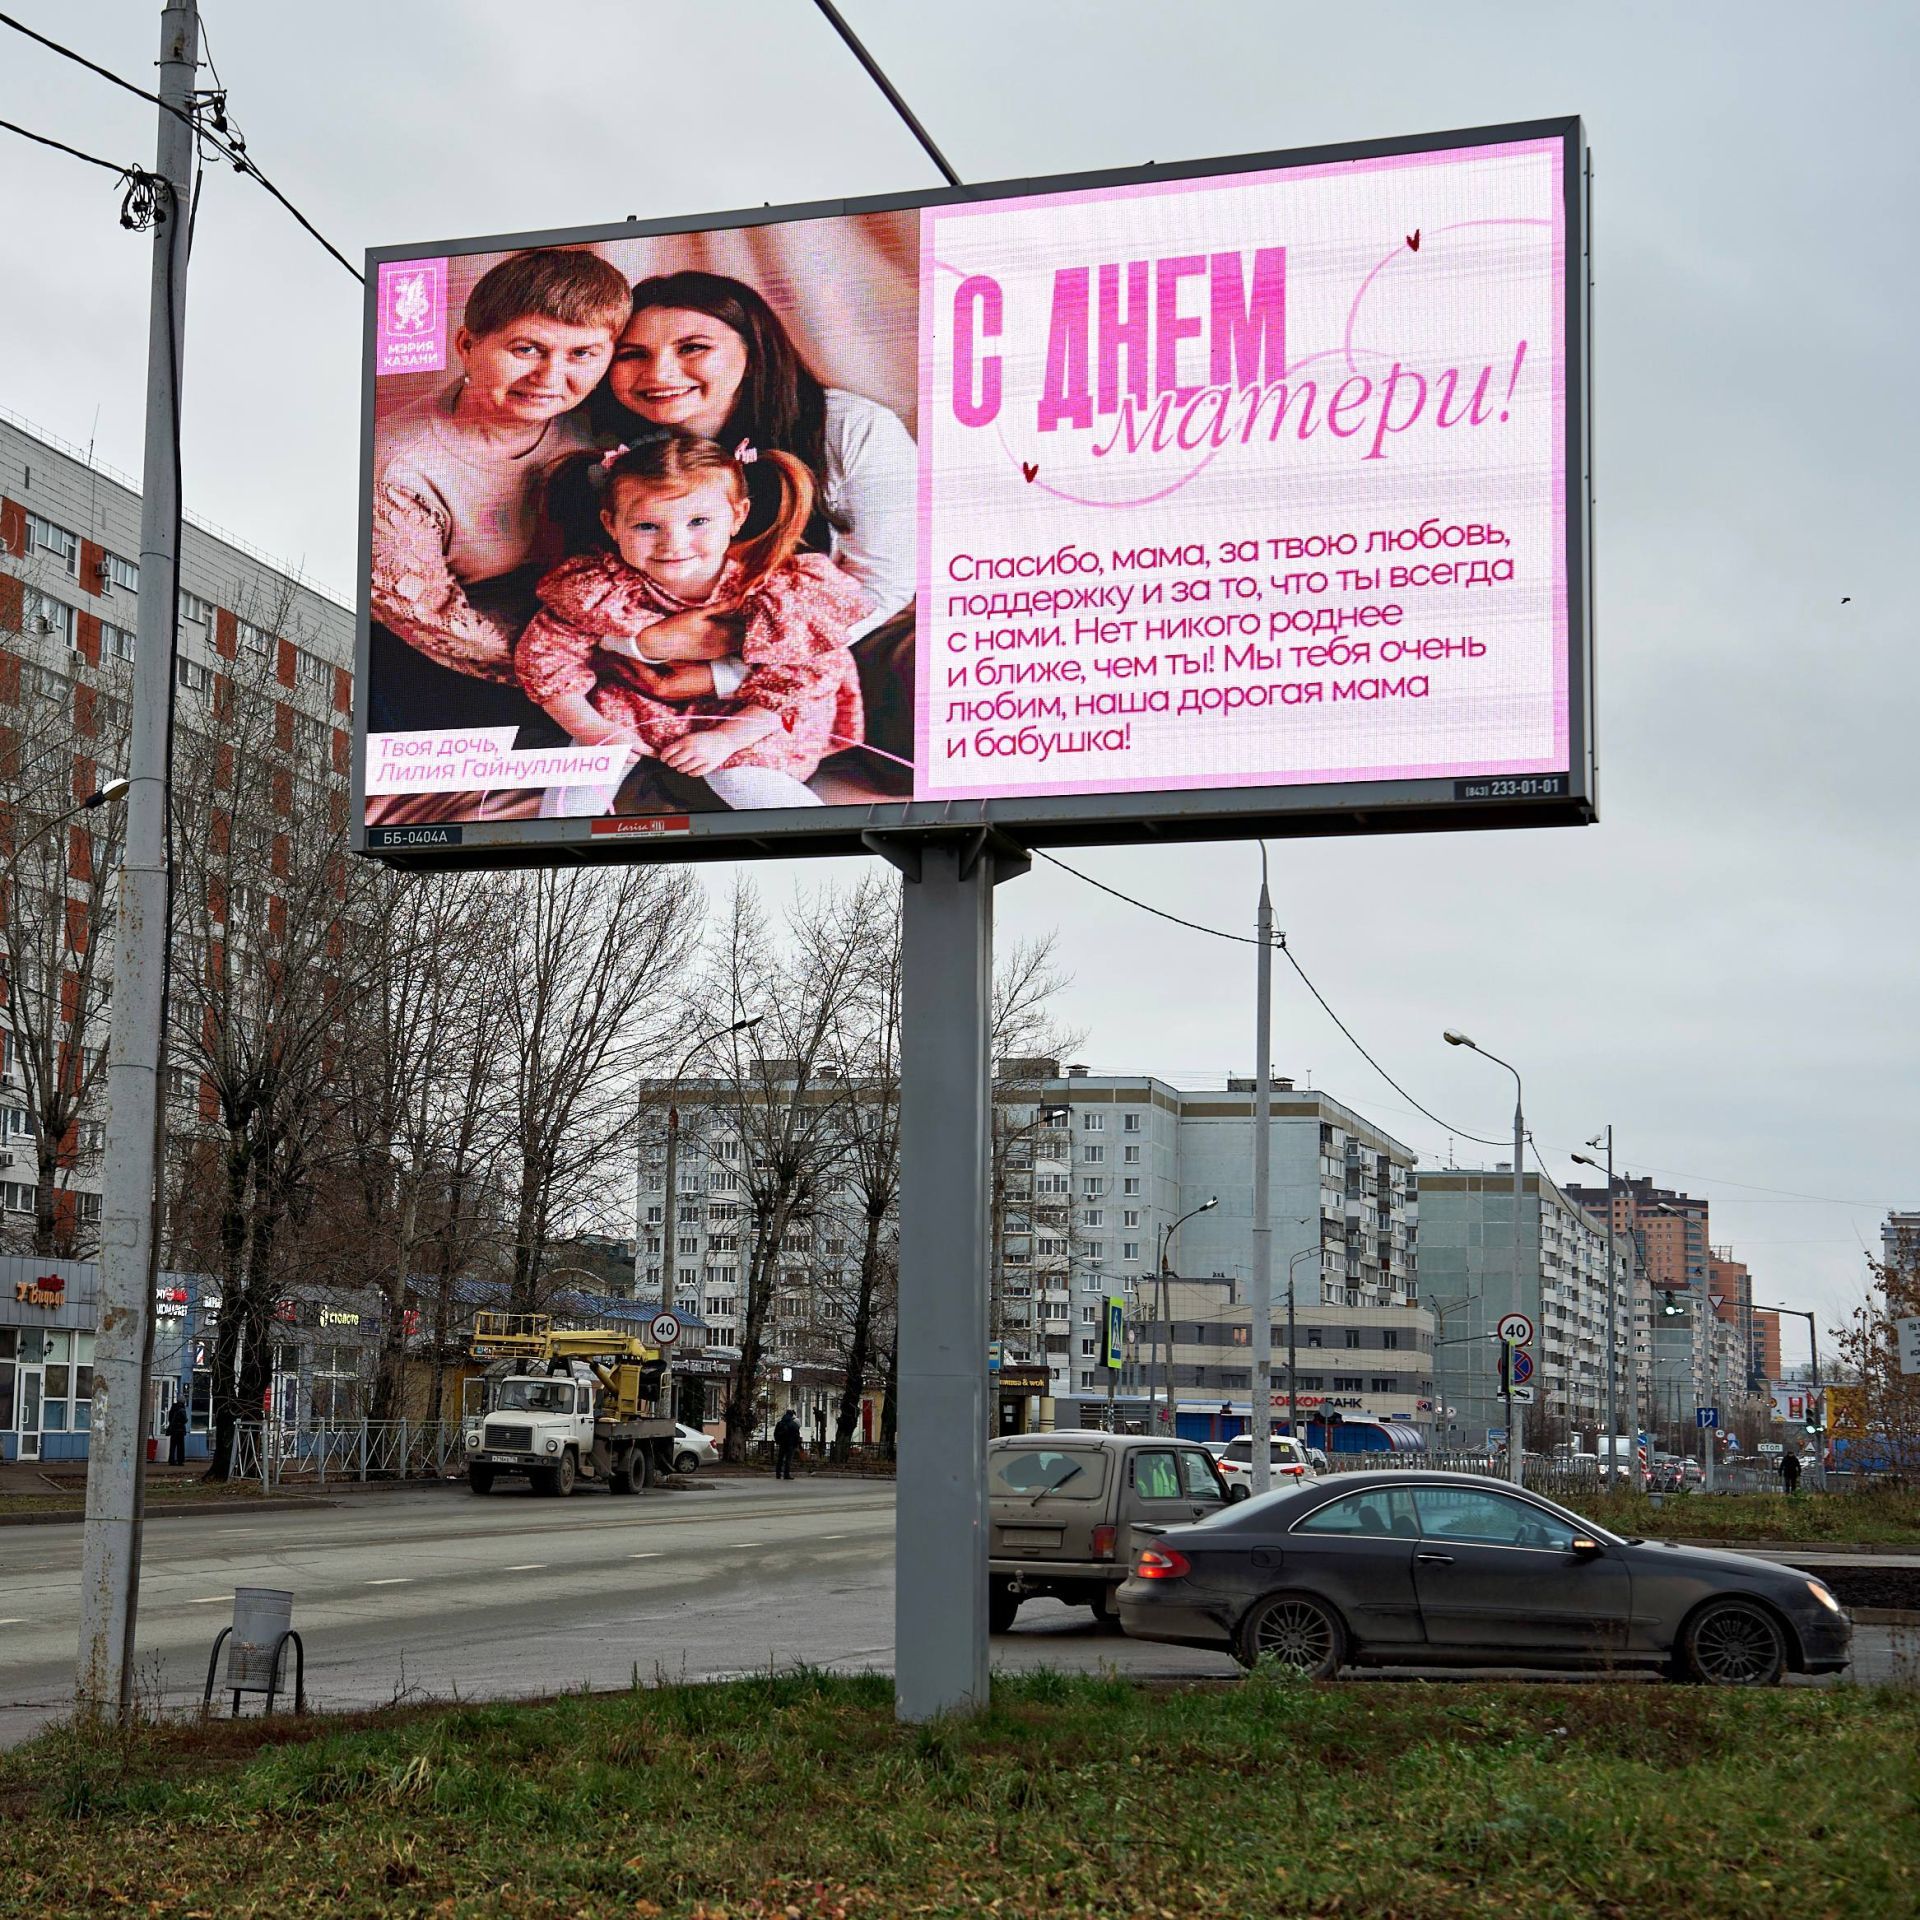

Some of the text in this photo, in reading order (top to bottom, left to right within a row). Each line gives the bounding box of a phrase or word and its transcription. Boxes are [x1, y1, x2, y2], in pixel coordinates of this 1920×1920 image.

[388, 341, 434, 354] МЭРИЯ
[953, 246, 1287, 432] С ДНЕМ
[384, 353, 437, 366] КАЗАНИ
[1092, 341, 1527, 460] матери!
[949, 518, 1510, 581] Спасибо, мама, за твою любовь,
[949, 558, 1513, 619] поддержку и за то, что ты всегда
[947, 604, 1403, 652] с нами. Нет никого роднее
[948, 636, 1486, 688] и ближе, чем ты! Мы тебя очень
[946, 676, 1428, 723] любим, наша дорогая мама
[380, 737, 498, 757] Твоя дочь,
[947, 722, 1130, 762] и бабушка!
[376, 755, 610, 782] Лилия Гайнуллина
[1492, 779, 1558, 796] 233-01-01
[383, 830, 447, 845] ББ-0404А
[657, 1323, 674, 1336] 40
[1505, 1324, 1526, 1338] 40
[1760, 1444, 1781, 1452] СТОП
